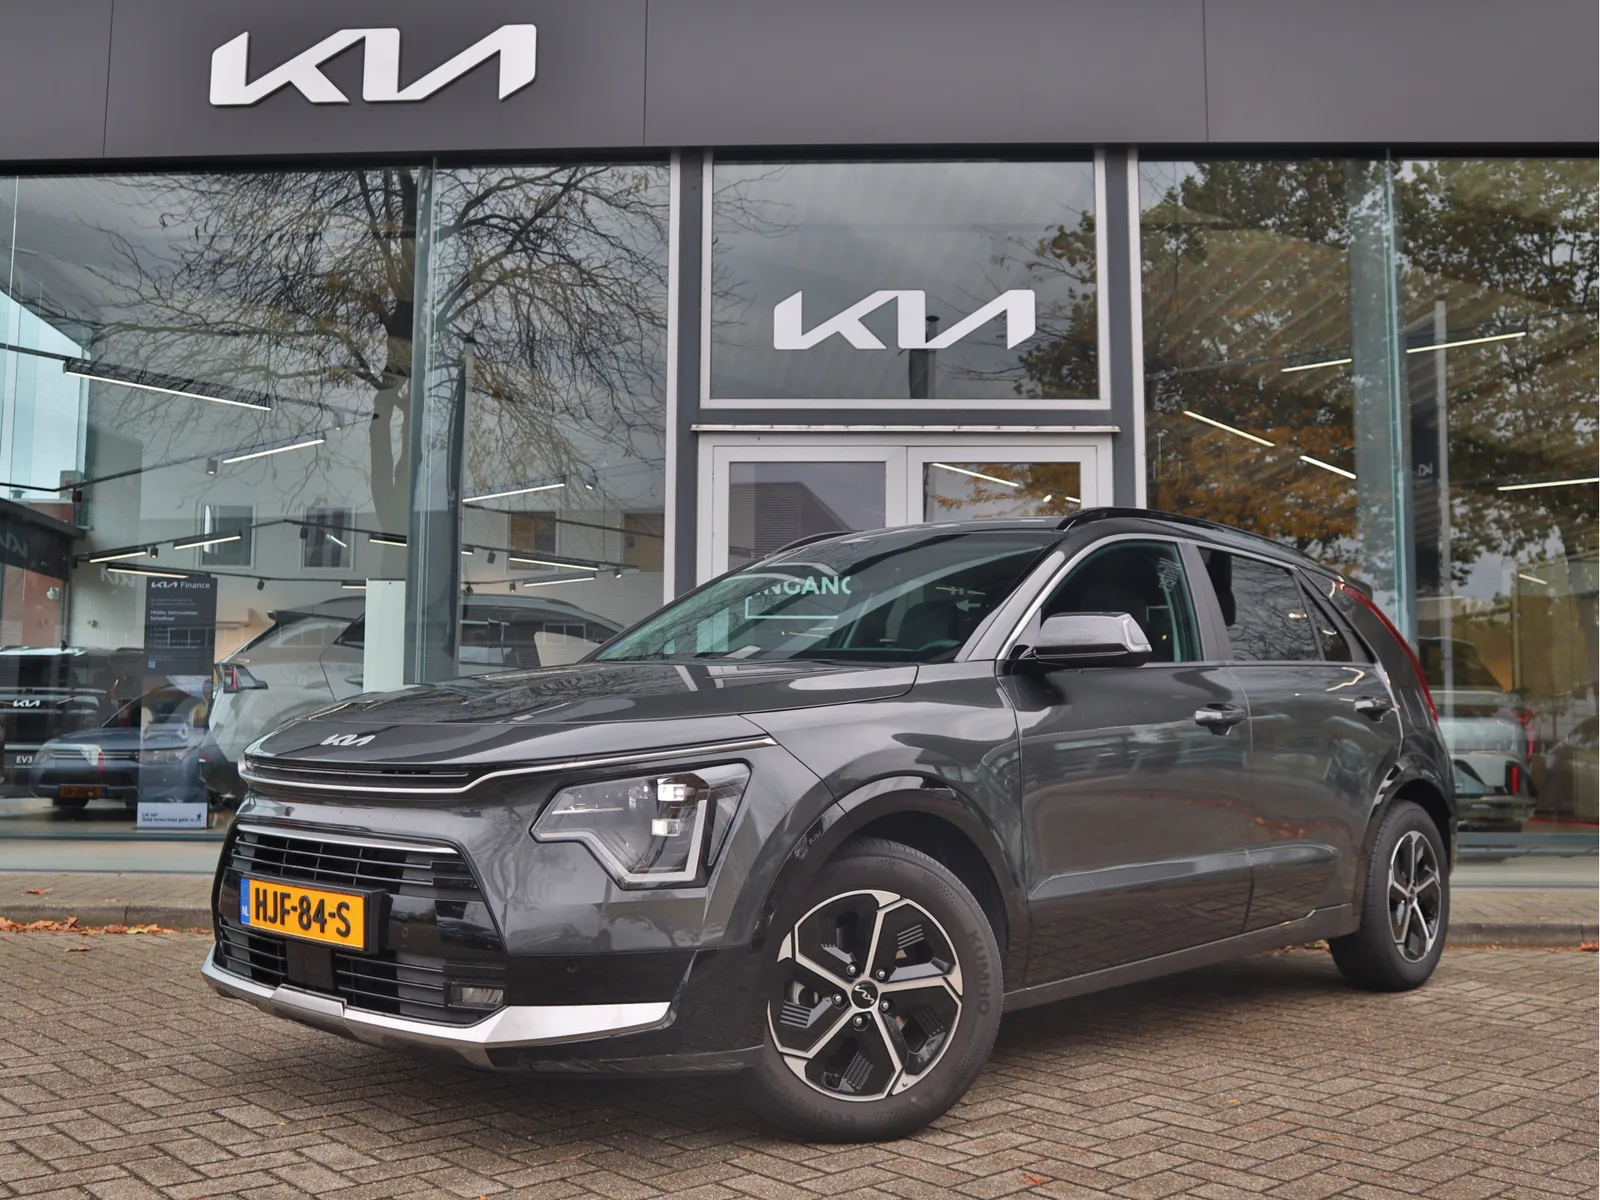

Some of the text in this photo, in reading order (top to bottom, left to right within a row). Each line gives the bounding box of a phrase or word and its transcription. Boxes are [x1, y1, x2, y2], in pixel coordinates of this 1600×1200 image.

[210, 24, 537, 106] KIA
[774, 290, 1036, 350] KIA
[180, 581, 211, 589] Finance
[756, 576, 852, 595] NGAN
[13, 699, 40, 707] KIA
[320, 733, 376, 747] KIA
[16, 756, 33, 764] EV3
[241, 906, 249, 917] NL
[255, 887, 351, 938] HJF-84-S
[968, 929, 991, 1015] KUMHO
